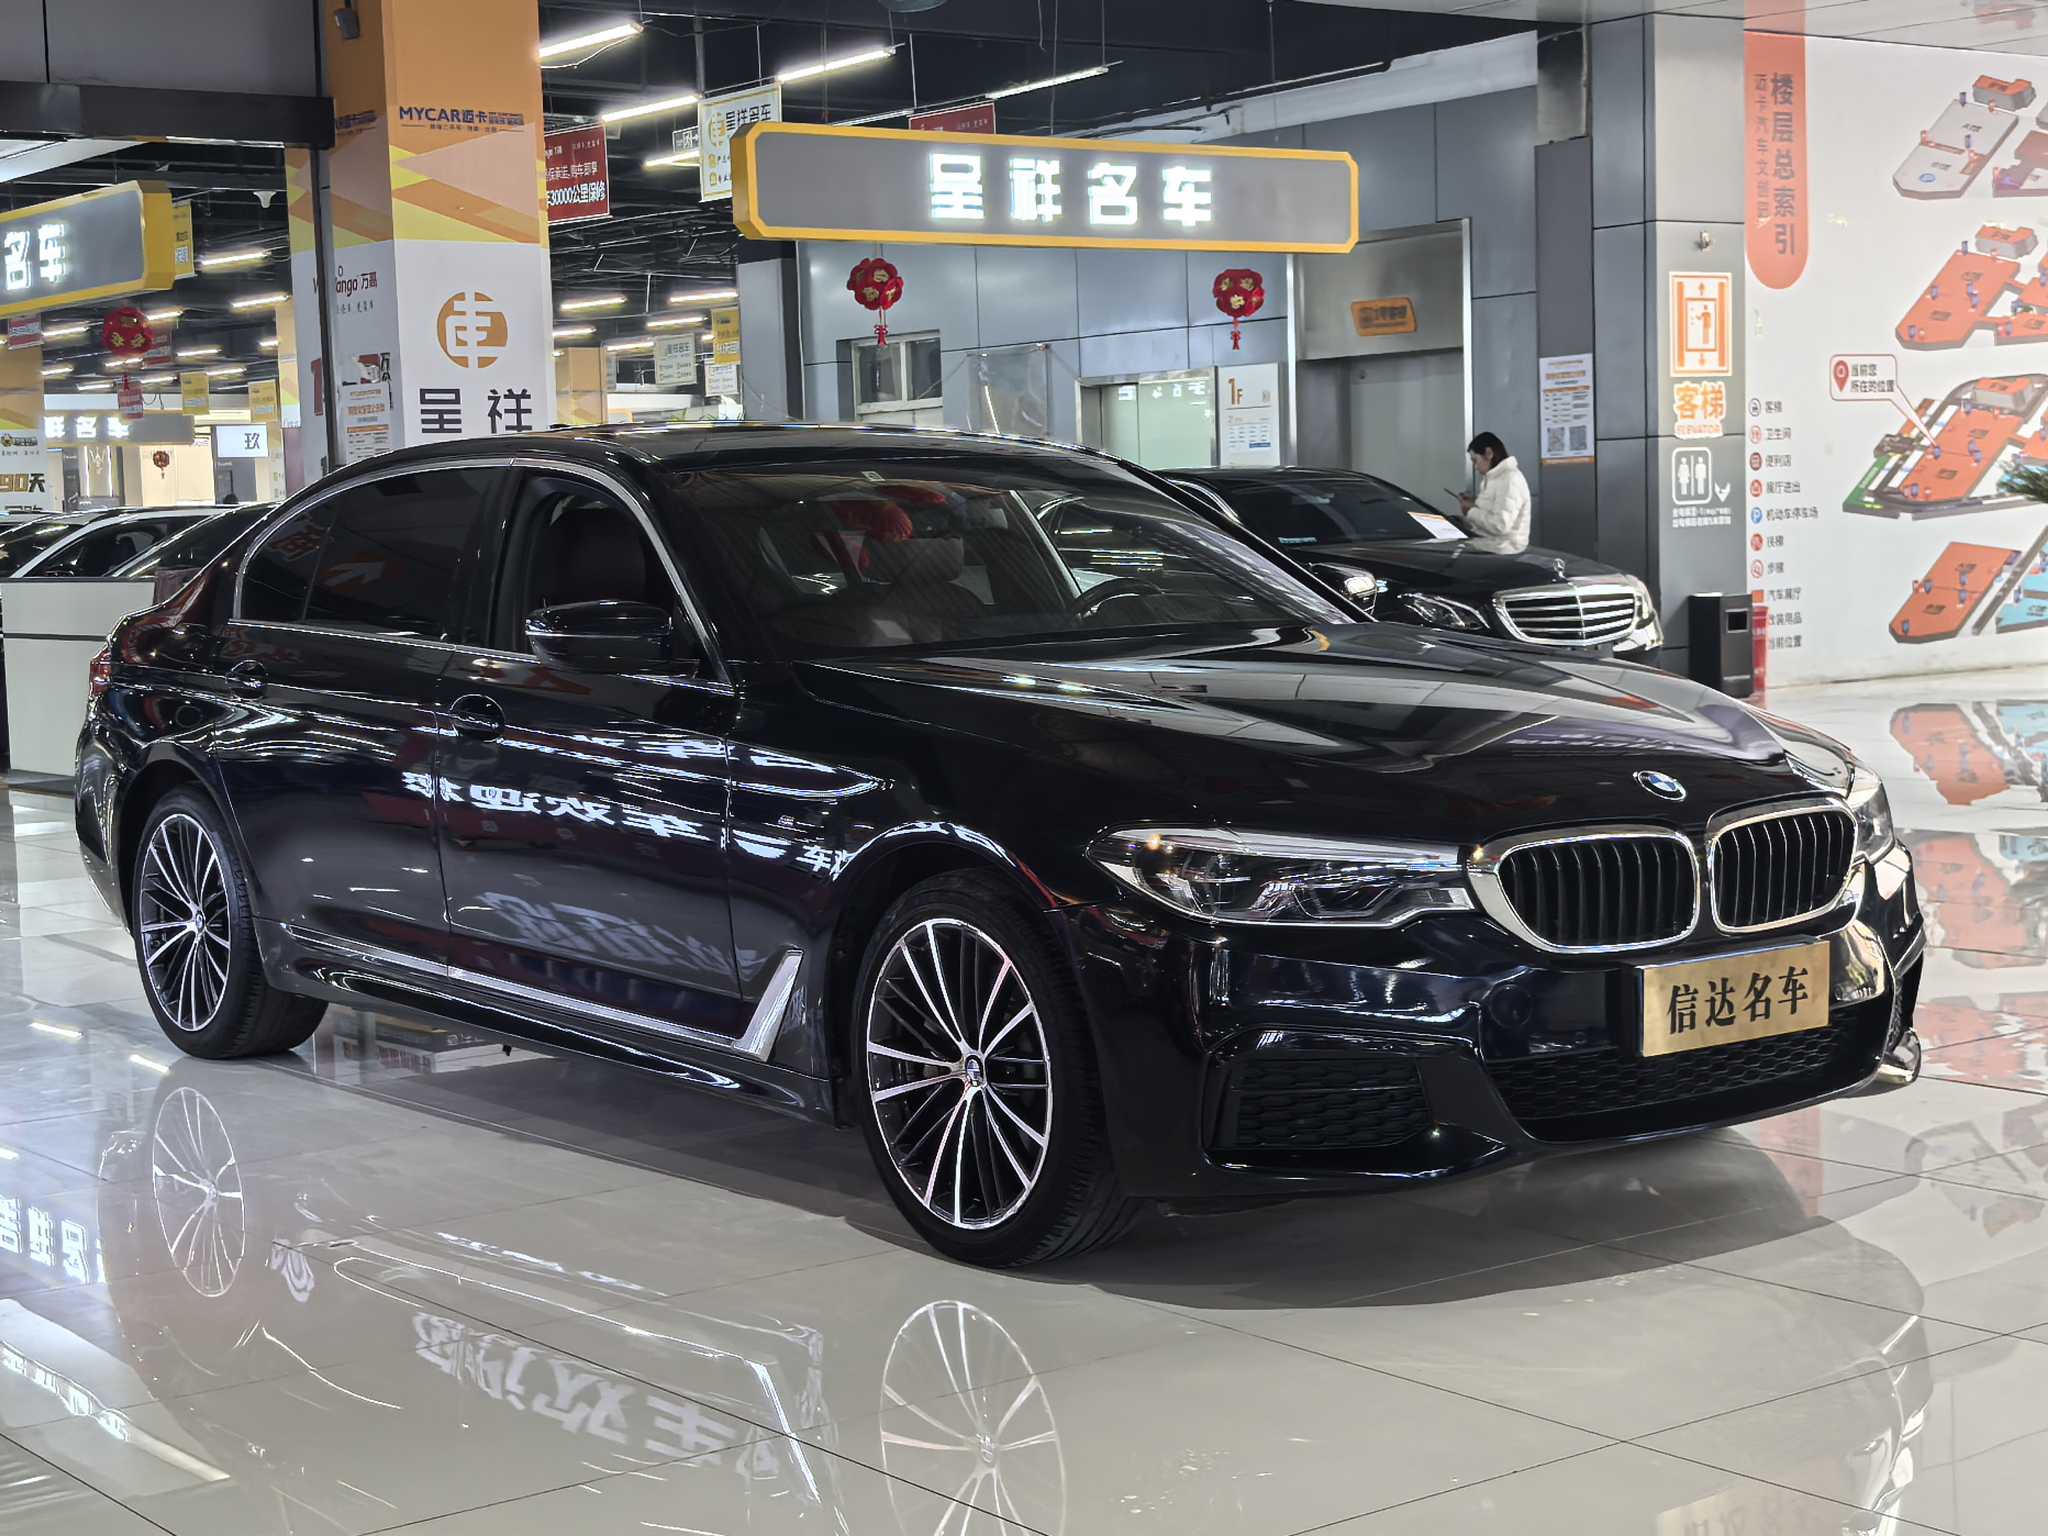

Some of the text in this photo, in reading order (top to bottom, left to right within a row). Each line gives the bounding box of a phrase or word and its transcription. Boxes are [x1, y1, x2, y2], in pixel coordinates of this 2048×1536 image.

[1771, 72, 1796, 256] 楼层总索引
[928, 152, 1213, 228] 呈祥名车
[1674, 382, 1725, 420] 客梯
[1850, 379, 1895, 393] 所在的位置
[419, 387, 533, 434] 呈祥
[1765, 426, 1792, 441] 卫生间
[1765, 454, 1792, 468] 便利店
[1766, 506, 1819, 522] 机动车停车场
[1666, 965, 1809, 1035] 信达名车
